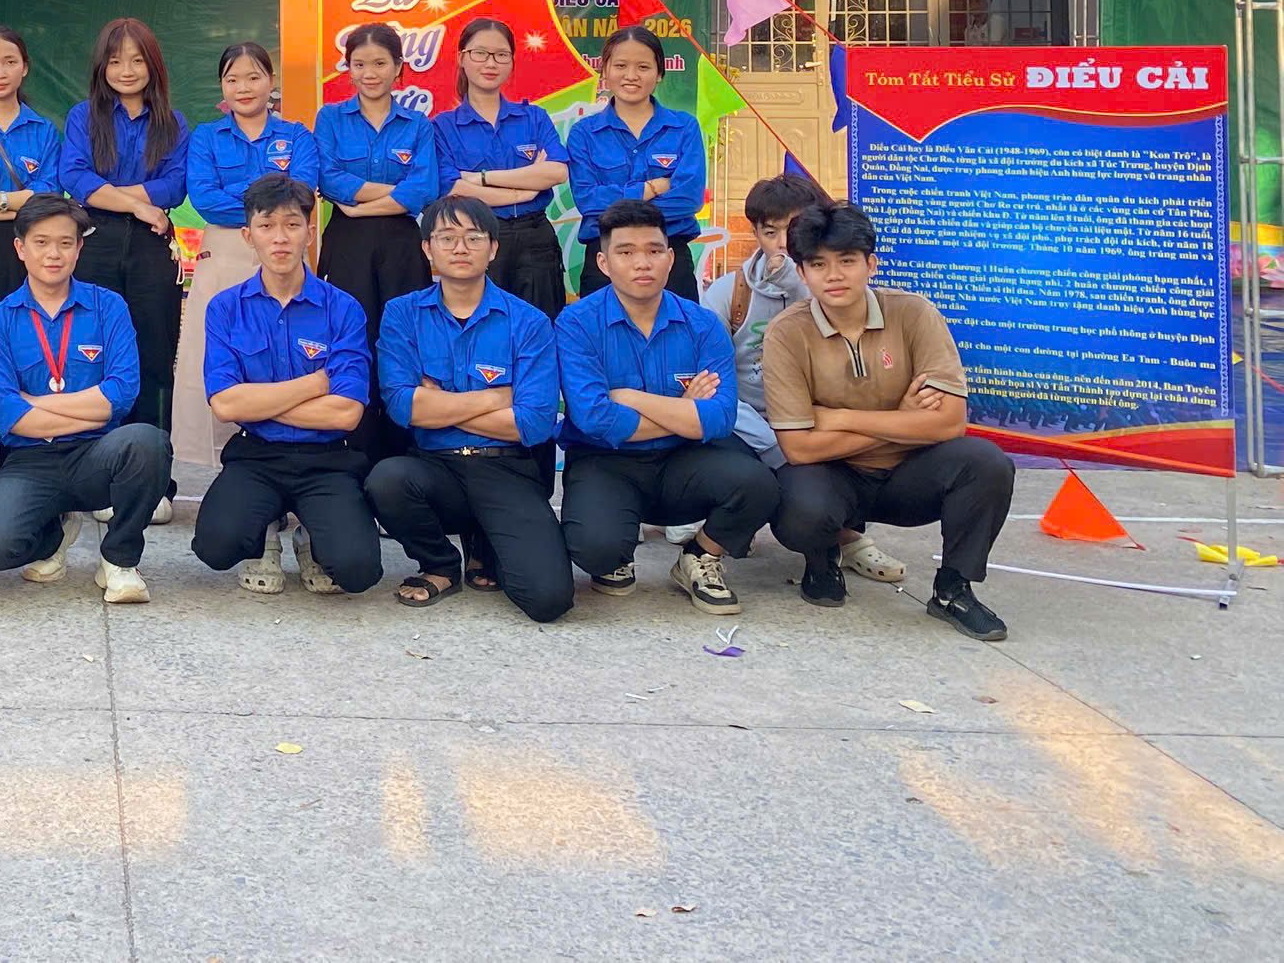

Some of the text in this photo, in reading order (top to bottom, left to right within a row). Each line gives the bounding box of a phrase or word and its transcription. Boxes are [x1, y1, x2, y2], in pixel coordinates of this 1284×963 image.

[593, 14, 620, 37] NĂ
[645, 18, 692, 37] 2026
[865, 57, 1209, 89] Tóm Tắt Tiểu Sử ĐIỂU CẢI
